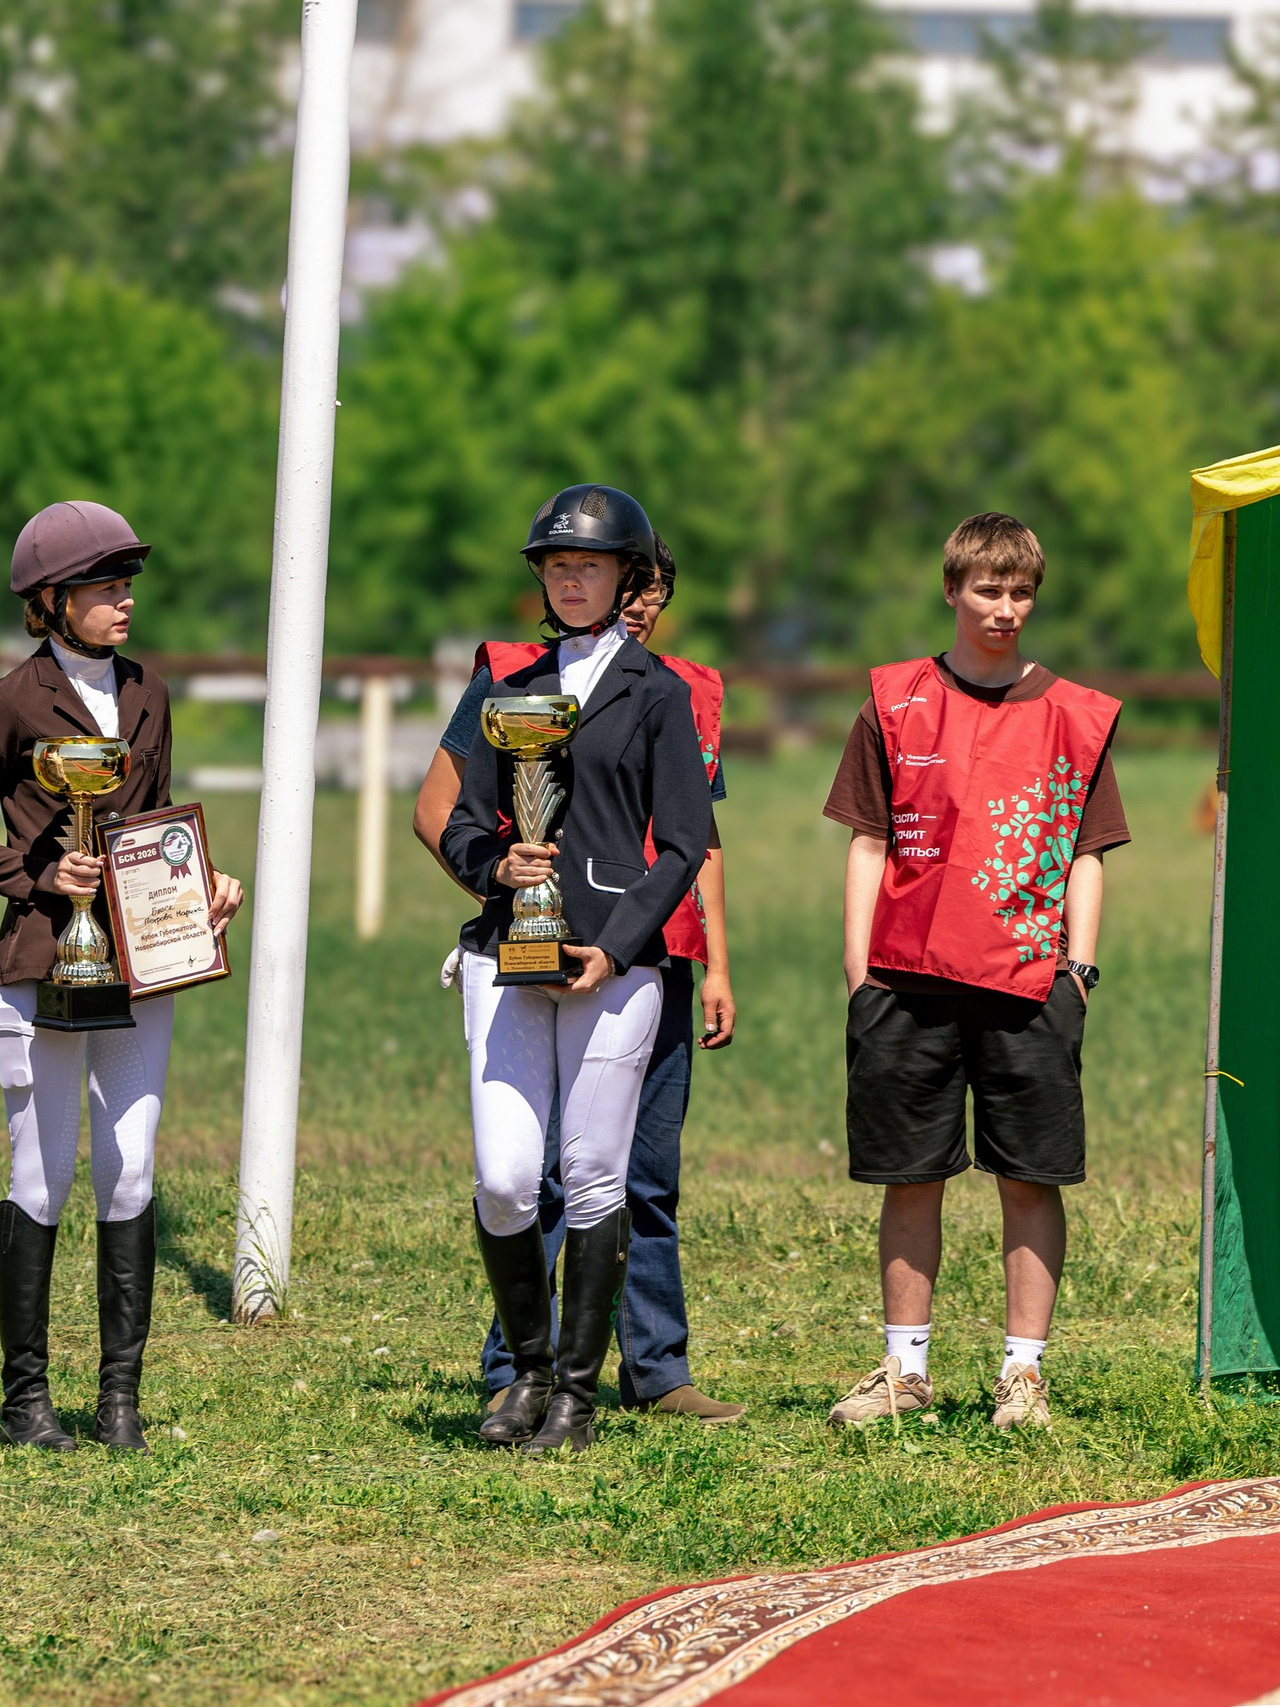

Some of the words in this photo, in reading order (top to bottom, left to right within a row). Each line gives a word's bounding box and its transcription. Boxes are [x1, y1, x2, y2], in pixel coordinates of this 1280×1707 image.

[118, 853, 136, 864] БСК
[137, 848, 157, 860] 2026
[148, 886, 178, 901] ДИПЛОМ
[141, 933, 158, 941] Кубок
[160, 923, 197, 937] Губернатора
[135, 935, 181, 952] Новосибирской
[182, 931, 207, 940] области
